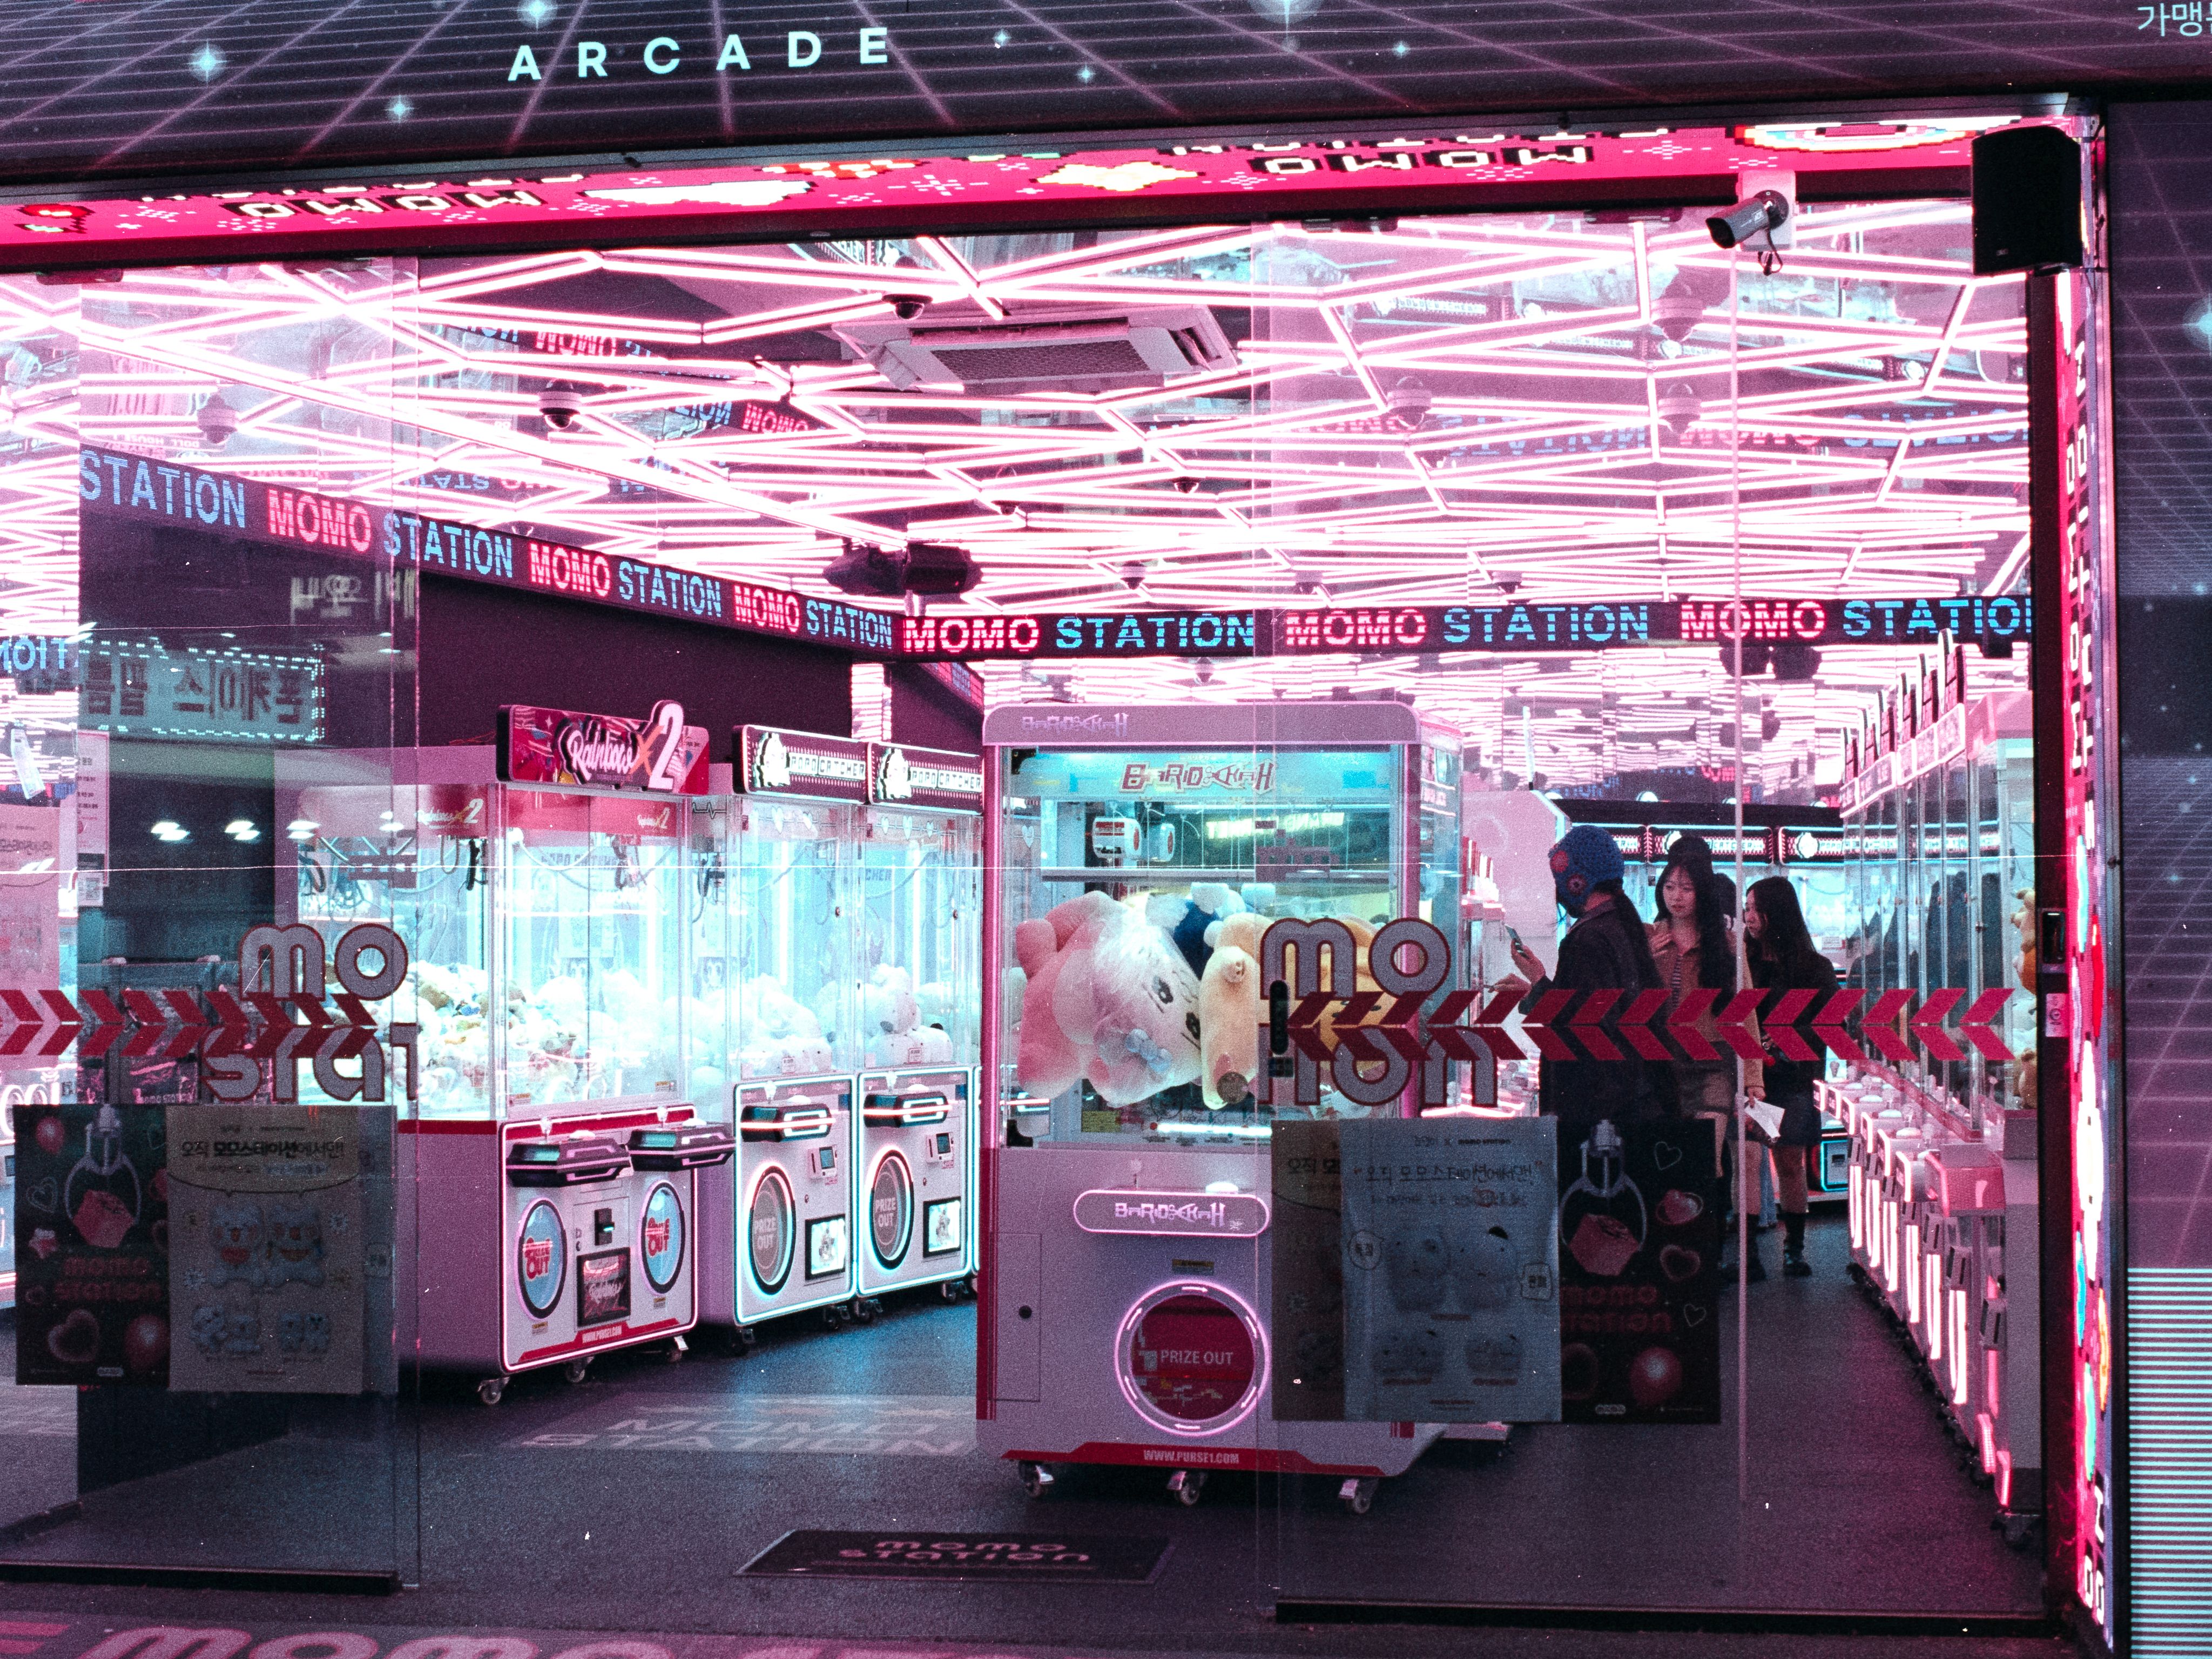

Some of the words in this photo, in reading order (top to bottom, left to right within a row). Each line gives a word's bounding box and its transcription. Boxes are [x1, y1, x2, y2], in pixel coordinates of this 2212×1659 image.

[508, 28, 888, 80] ARCADE
[79, 449, 245, 528] STATION
[268, 489, 371, 552] MOMO
[383, 512, 513, 578] STATION
[529, 542, 611, 597] MOMO
[619, 561, 721, 617] STATION
[734, 585, 800, 633] MOMO
[807, 599, 893, 649] STATION
[903, 617, 1040, 652] MOMO
[1056, 613, 1254, 649] STATION
[1286, 608, 1427, 646] MOMO
[1444, 604, 1648, 643] STATION
[1681, 601, 1825, 639] MOMO
[1843, 599, 2031, 637] STATIO
[791, 756, 817, 773] POPO
[819, 759, 865, 778] CATCHER
[912, 769, 936, 785] POPO
[939, 772, 982, 790] CATCHER
[1714, 841, 1758, 849] CATCER
[239, 923, 409, 1001] mo
[1260, 918, 1451, 1000] mo
[875, 1196, 898, 1212] PRIZE
[754, 1217, 776, 1231] PRIZE
[878, 1213, 895, 1229] OUT
[757, 1235, 774, 1250] OUT
[1160, 1349, 1201, 1364] PRIZE
[1204, 1351, 1234, 1365] OUT
[1143, 1449, 1240, 1465] WWW.PURSE1.COM
[874, 1540, 1068, 1553] momo
